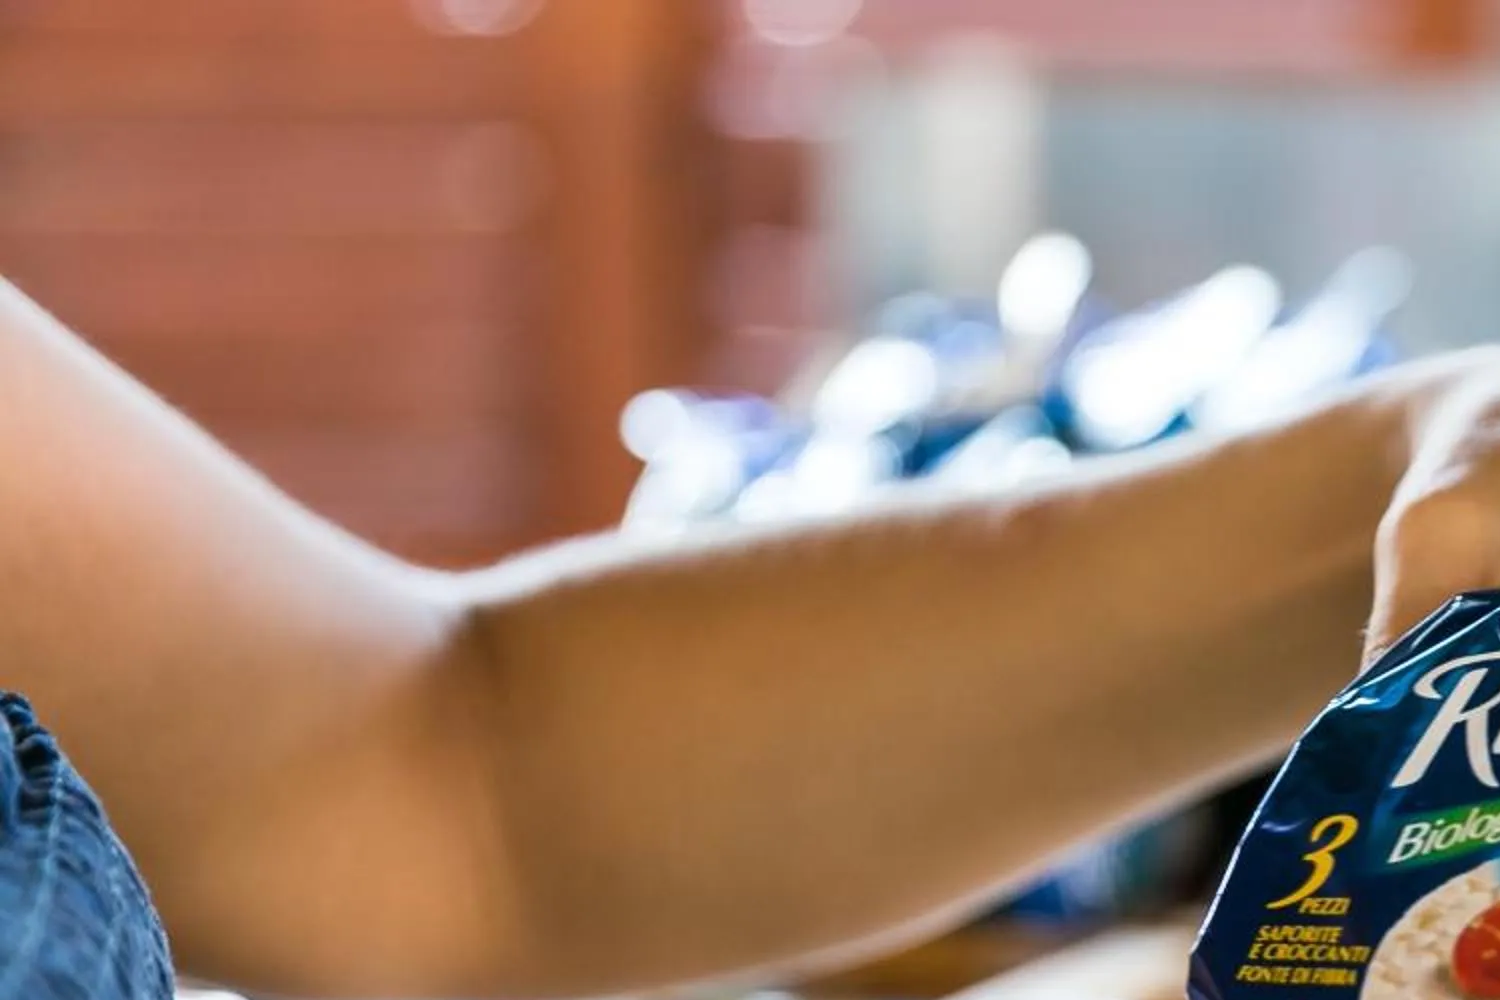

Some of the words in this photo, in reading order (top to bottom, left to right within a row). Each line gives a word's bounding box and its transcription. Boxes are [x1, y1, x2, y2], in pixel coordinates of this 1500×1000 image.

[1266, 814, 1359, 909] 3
[1299, 897, 1351, 916] PEZZI
[1256, 925, 1343, 943] SAPORITE
[1248, 943, 1263, 960] E
[1263, 944, 1371, 963] CROCCANTI
[1236, 965, 1291, 983] FONTE
[1292, 967, 1312, 984] DI
